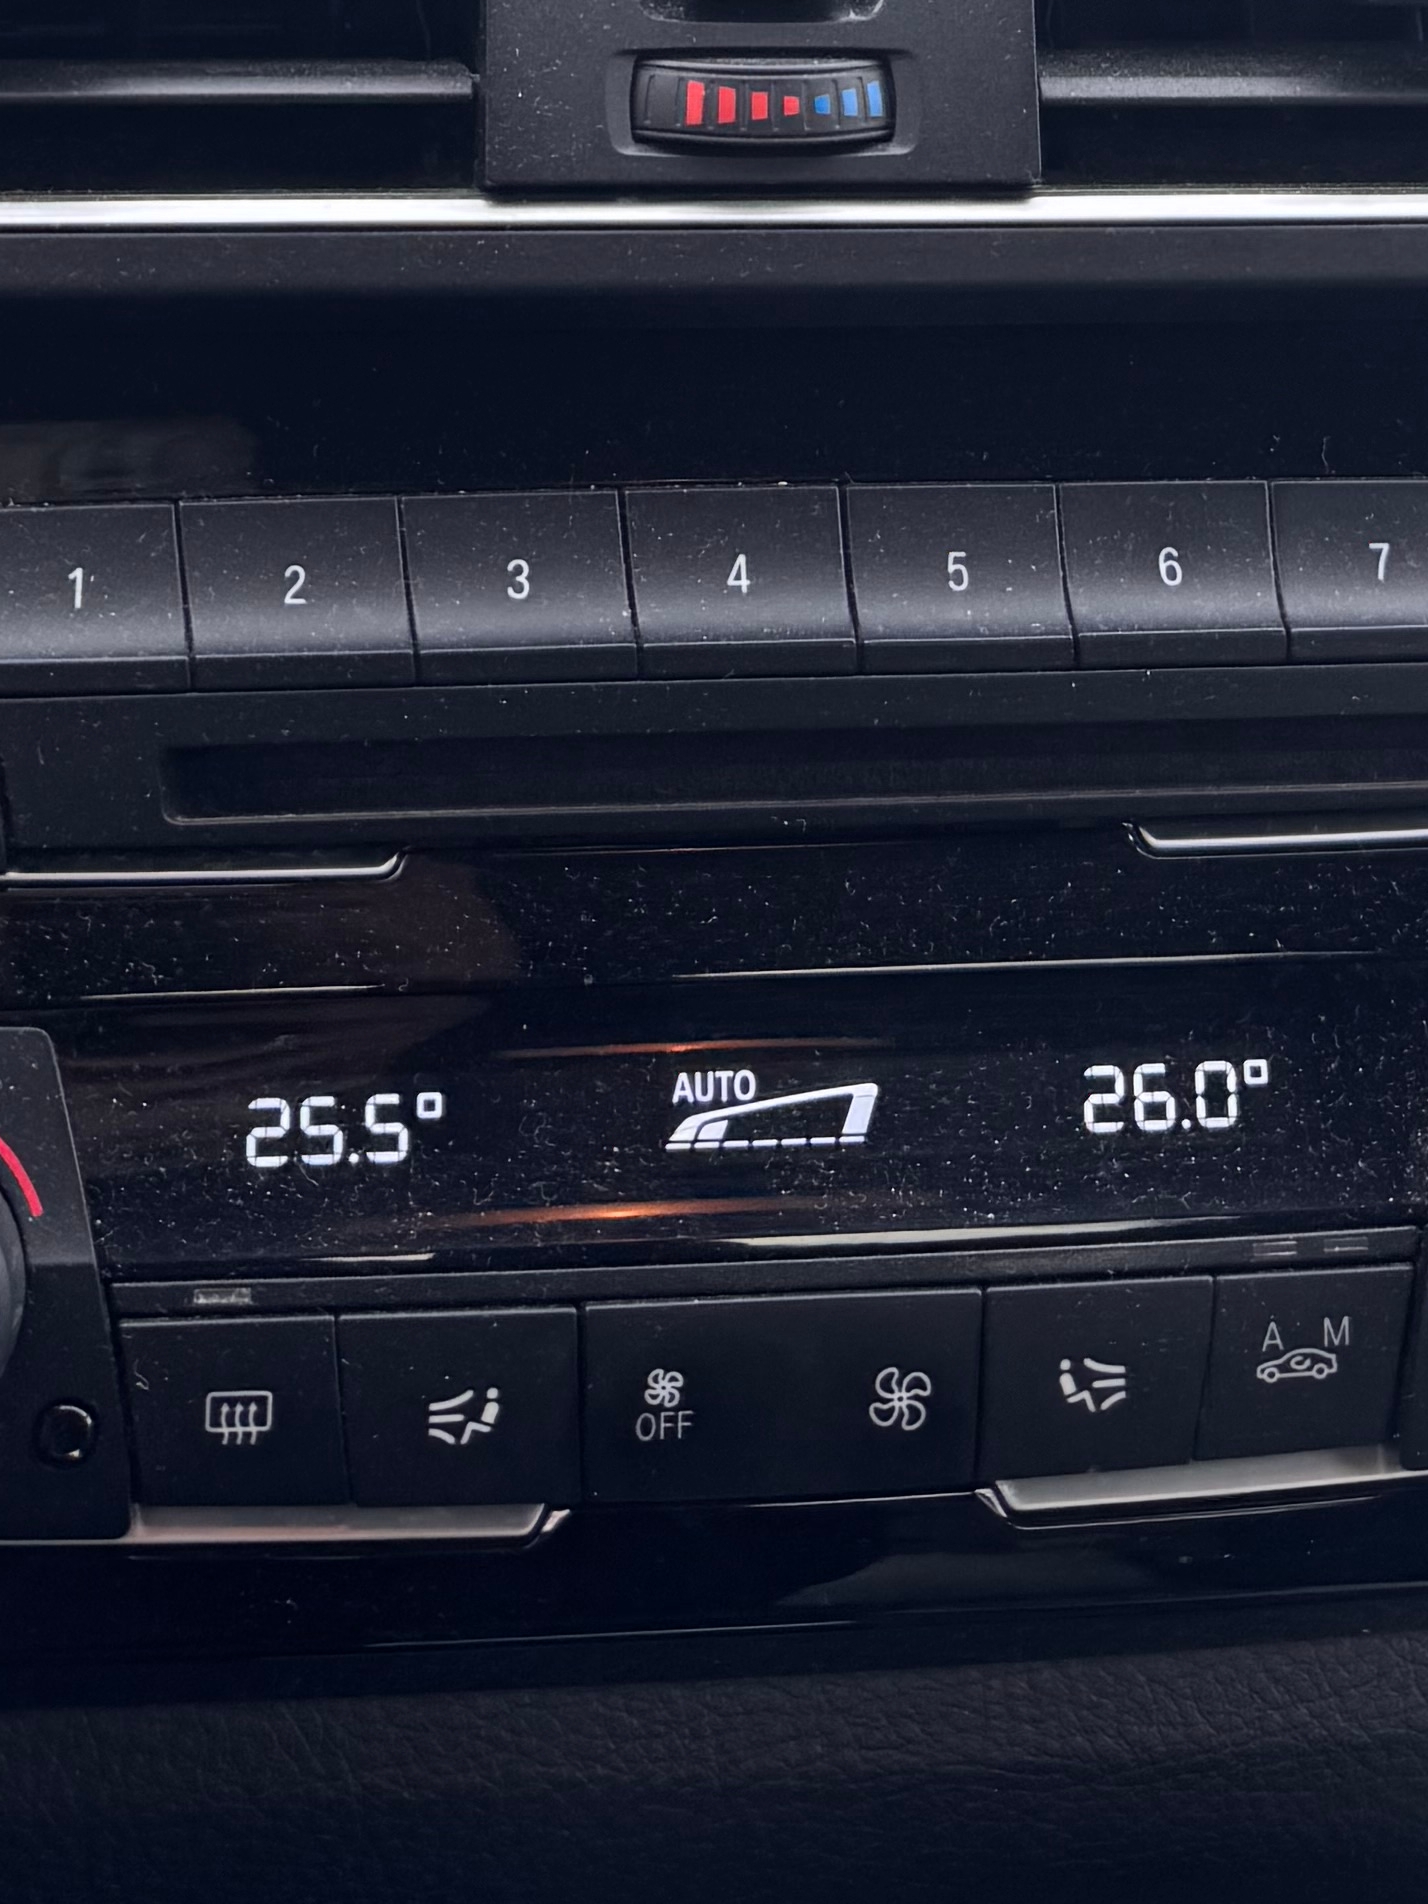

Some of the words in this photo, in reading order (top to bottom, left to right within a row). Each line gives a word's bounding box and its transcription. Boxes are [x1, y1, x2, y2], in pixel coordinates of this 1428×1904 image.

[508, 560, 529, 599] 3
[727, 554, 750, 594] 4
[948, 552, 968, 591] 5
[1159, 547, 1182, 586] 6
[1369, 543, 1389, 582] 7
[68, 568, 85, 608] 1
[284, 565, 307, 604] 2
[672, 1070, 756, 1104] AUTO
[1262, 1321, 1284, 1350] A
[1322, 1316, 1351, 1349] M
[635, 1410, 694, 1442] OFF
